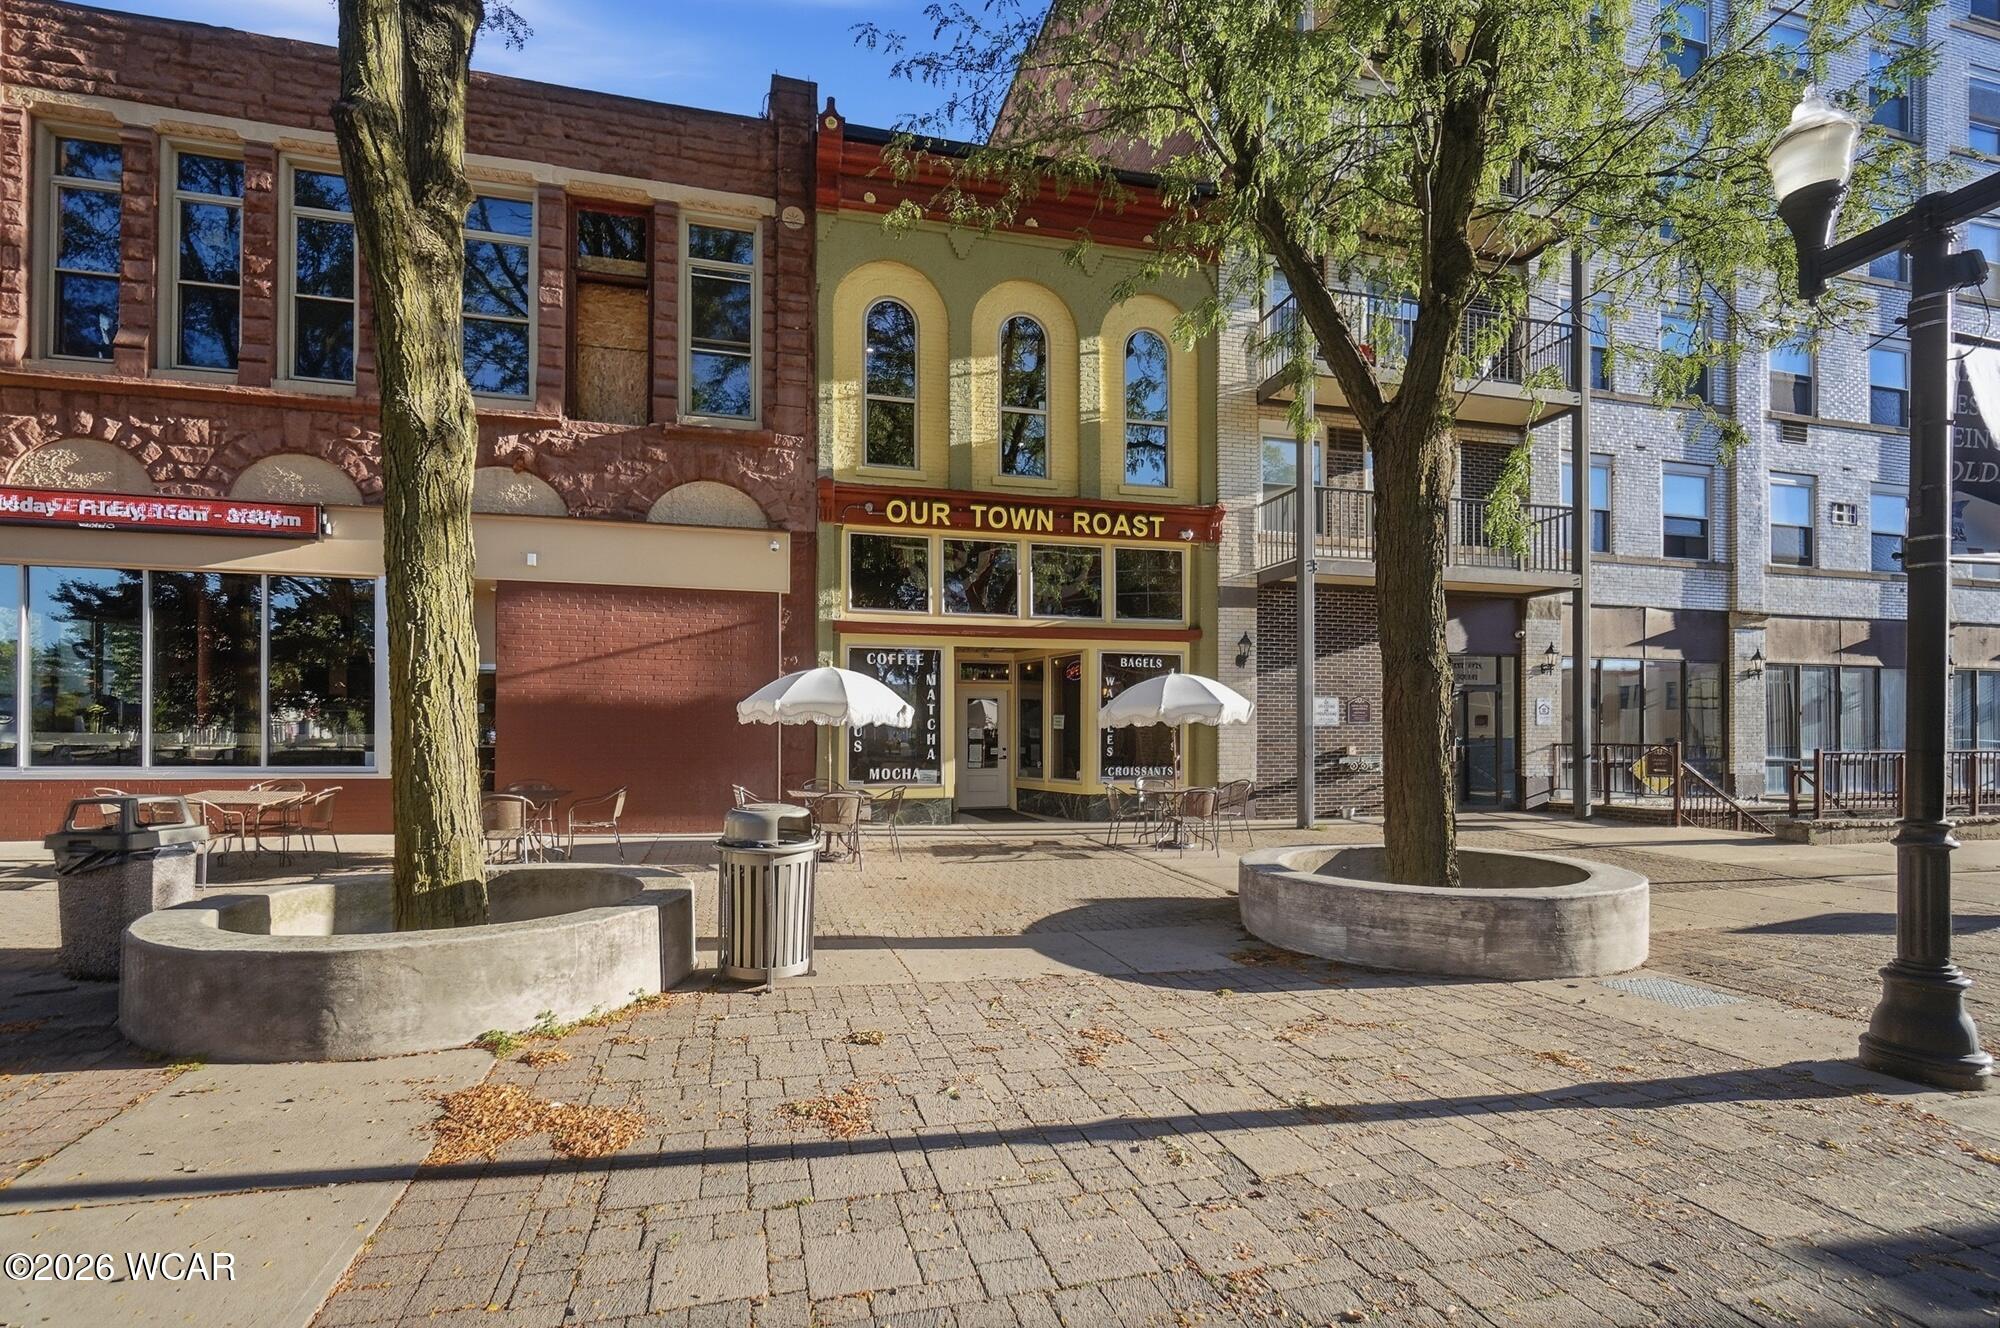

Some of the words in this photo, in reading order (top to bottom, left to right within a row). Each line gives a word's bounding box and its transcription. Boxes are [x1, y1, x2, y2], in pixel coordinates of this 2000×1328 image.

[886, 500, 951, 526] OUR
[970, 505, 1054, 532] TOWN
[1073, 512, 1165, 538] ROAST
[866, 652, 925, 666] COFFEE
[1120, 657, 1162, 668] BAGELS
[926, 672, 936, 760] MATCHA
[869, 768, 921, 780] MOCHA
[1107, 766, 1174, 777] CROISSANTS
